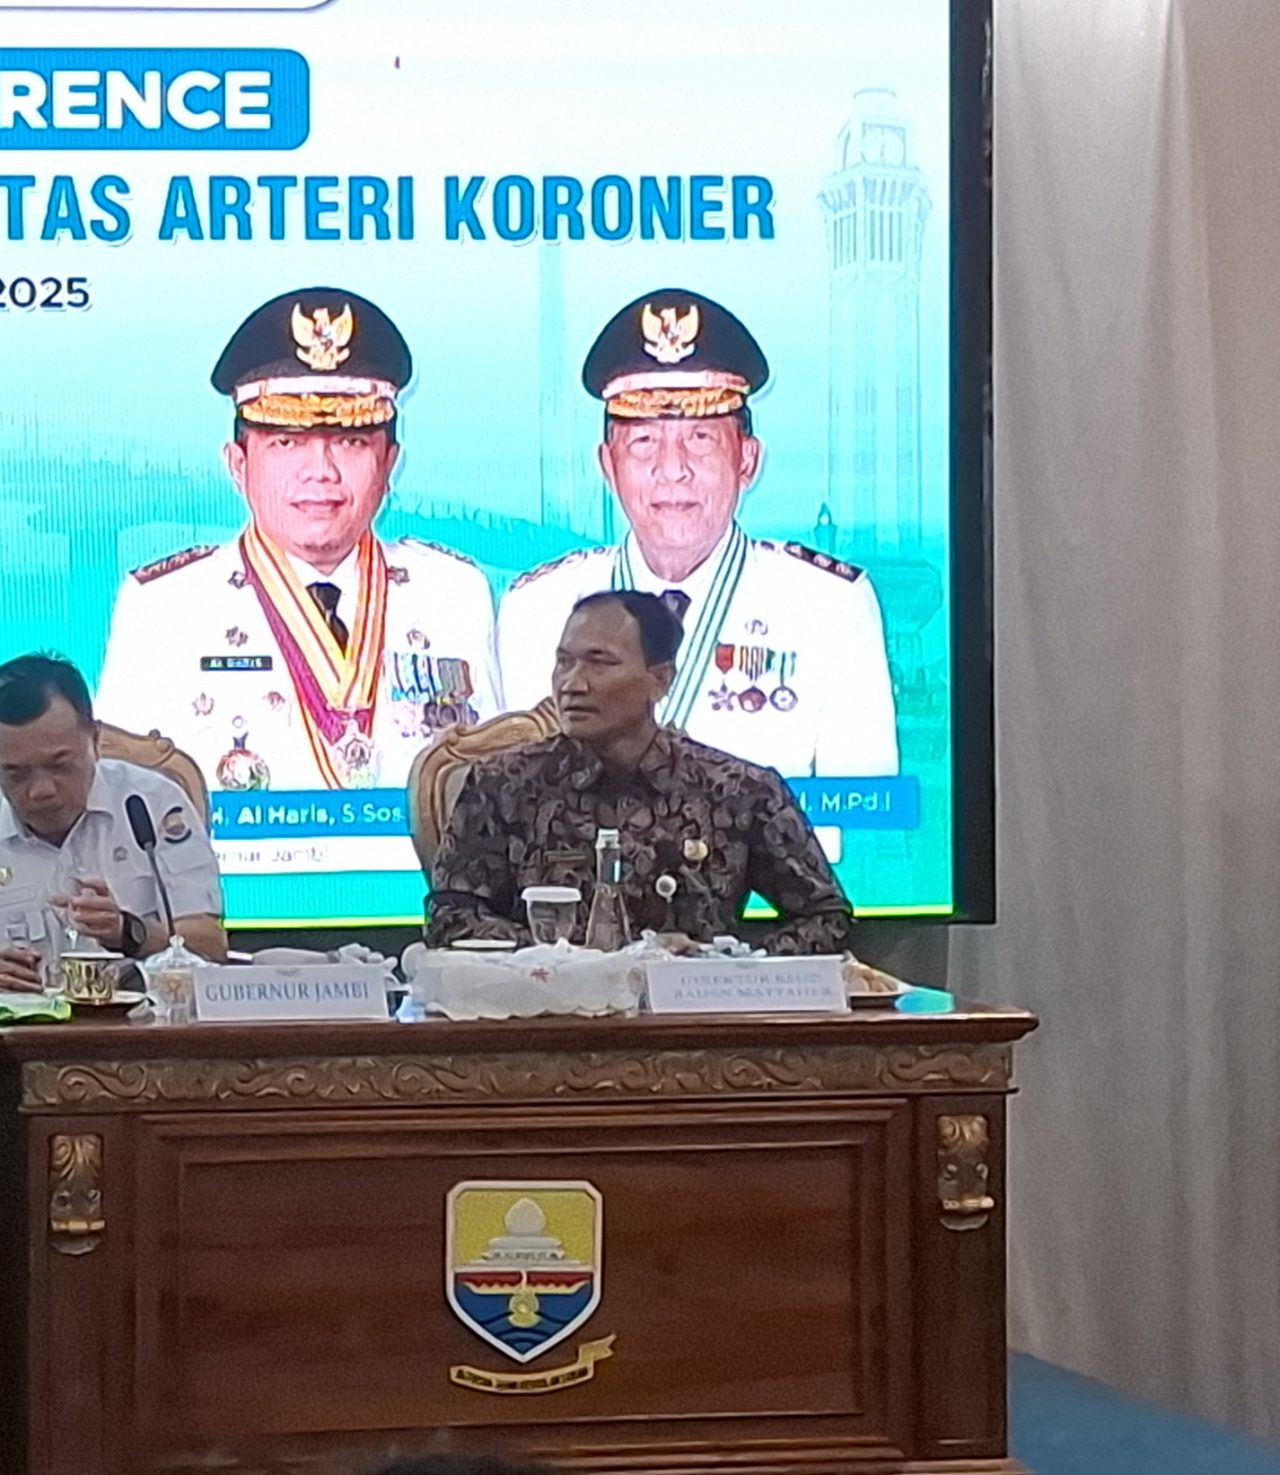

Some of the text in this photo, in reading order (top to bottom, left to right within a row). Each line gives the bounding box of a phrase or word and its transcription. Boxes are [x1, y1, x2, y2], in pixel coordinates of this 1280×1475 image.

[158, 175, 415, 242] ARTERI
[444, 174, 775, 242] KORONER
[236, 805, 263, 825] Al
[205, 980, 370, 1004] GUBERNUR JAMBI
